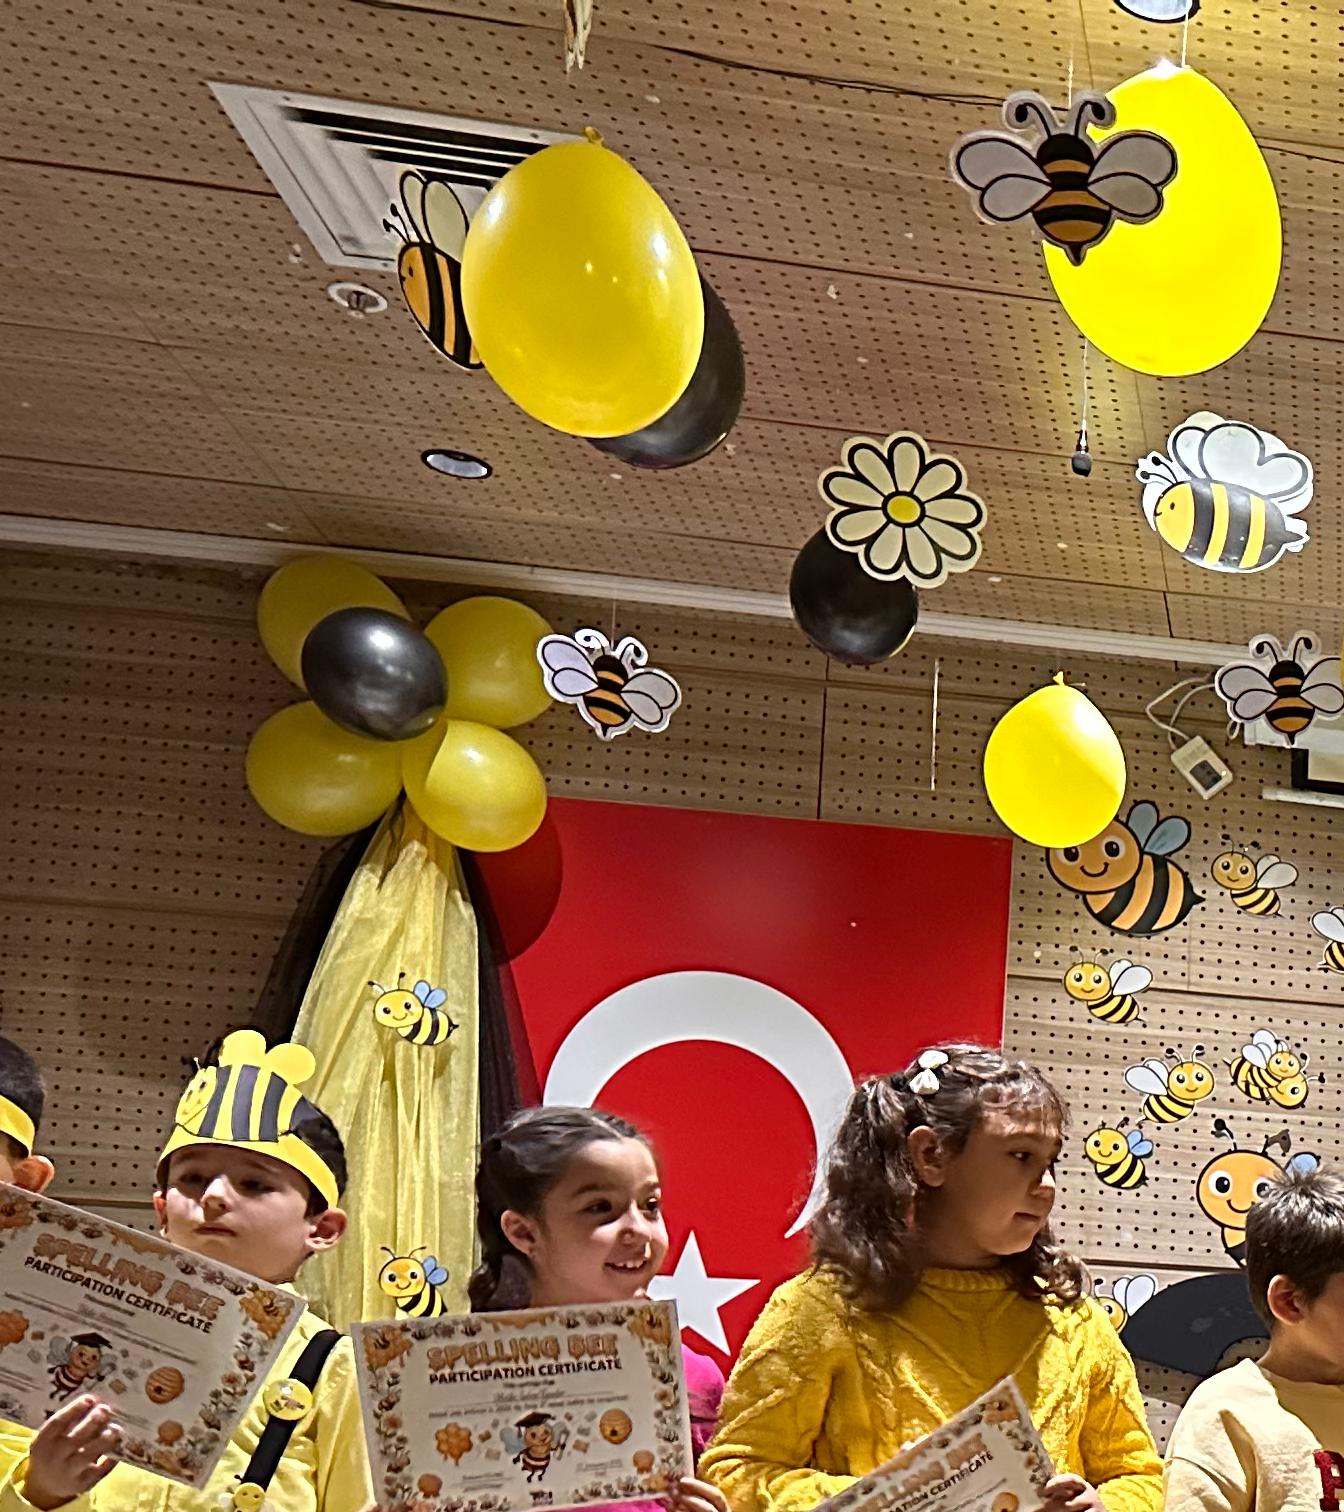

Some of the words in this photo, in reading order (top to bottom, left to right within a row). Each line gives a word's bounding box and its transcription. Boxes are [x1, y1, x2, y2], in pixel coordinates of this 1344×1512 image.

[24, 1256, 125, 1302] PARTICIPATION
[125, 1292, 213, 1334] CERTIFICATE
[427, 1334, 561, 1371] SPELLING
[568, 1333, 619, 1359] BEE
[429, 1366, 536, 1384] PARTICIPATION
[538, 1358, 622, 1377] CERTIFICATE
